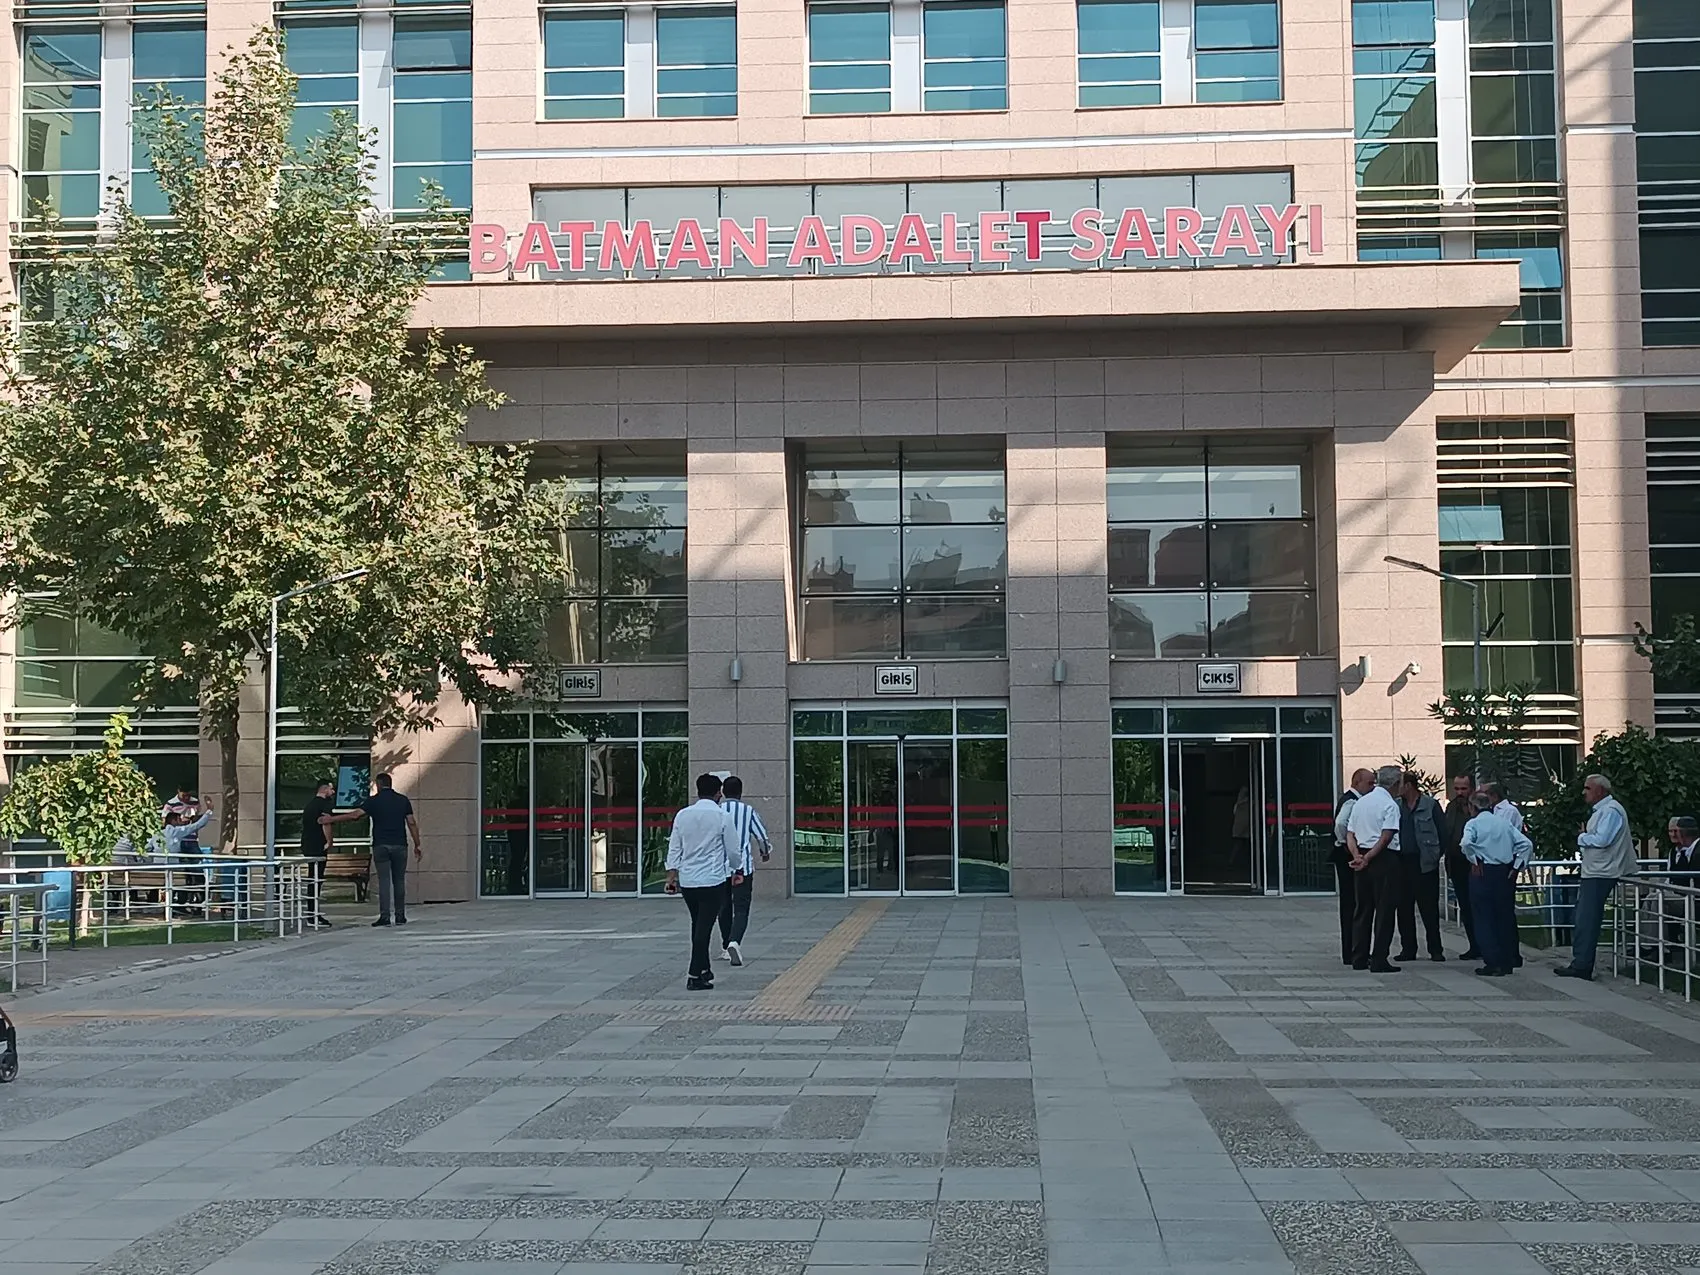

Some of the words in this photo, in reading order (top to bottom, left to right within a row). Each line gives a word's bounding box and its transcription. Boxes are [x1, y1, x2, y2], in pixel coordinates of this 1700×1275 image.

[470, 216, 769, 273] BATMAN
[786, 211, 1051, 268] ADALET
[1068, 204, 1325, 262] SARAYI
[564, 675, 596, 690] GİRİŞ
[881, 672, 912, 686] GİRİŞ
[1202, 673, 1235, 685] ÇIKIŞ
